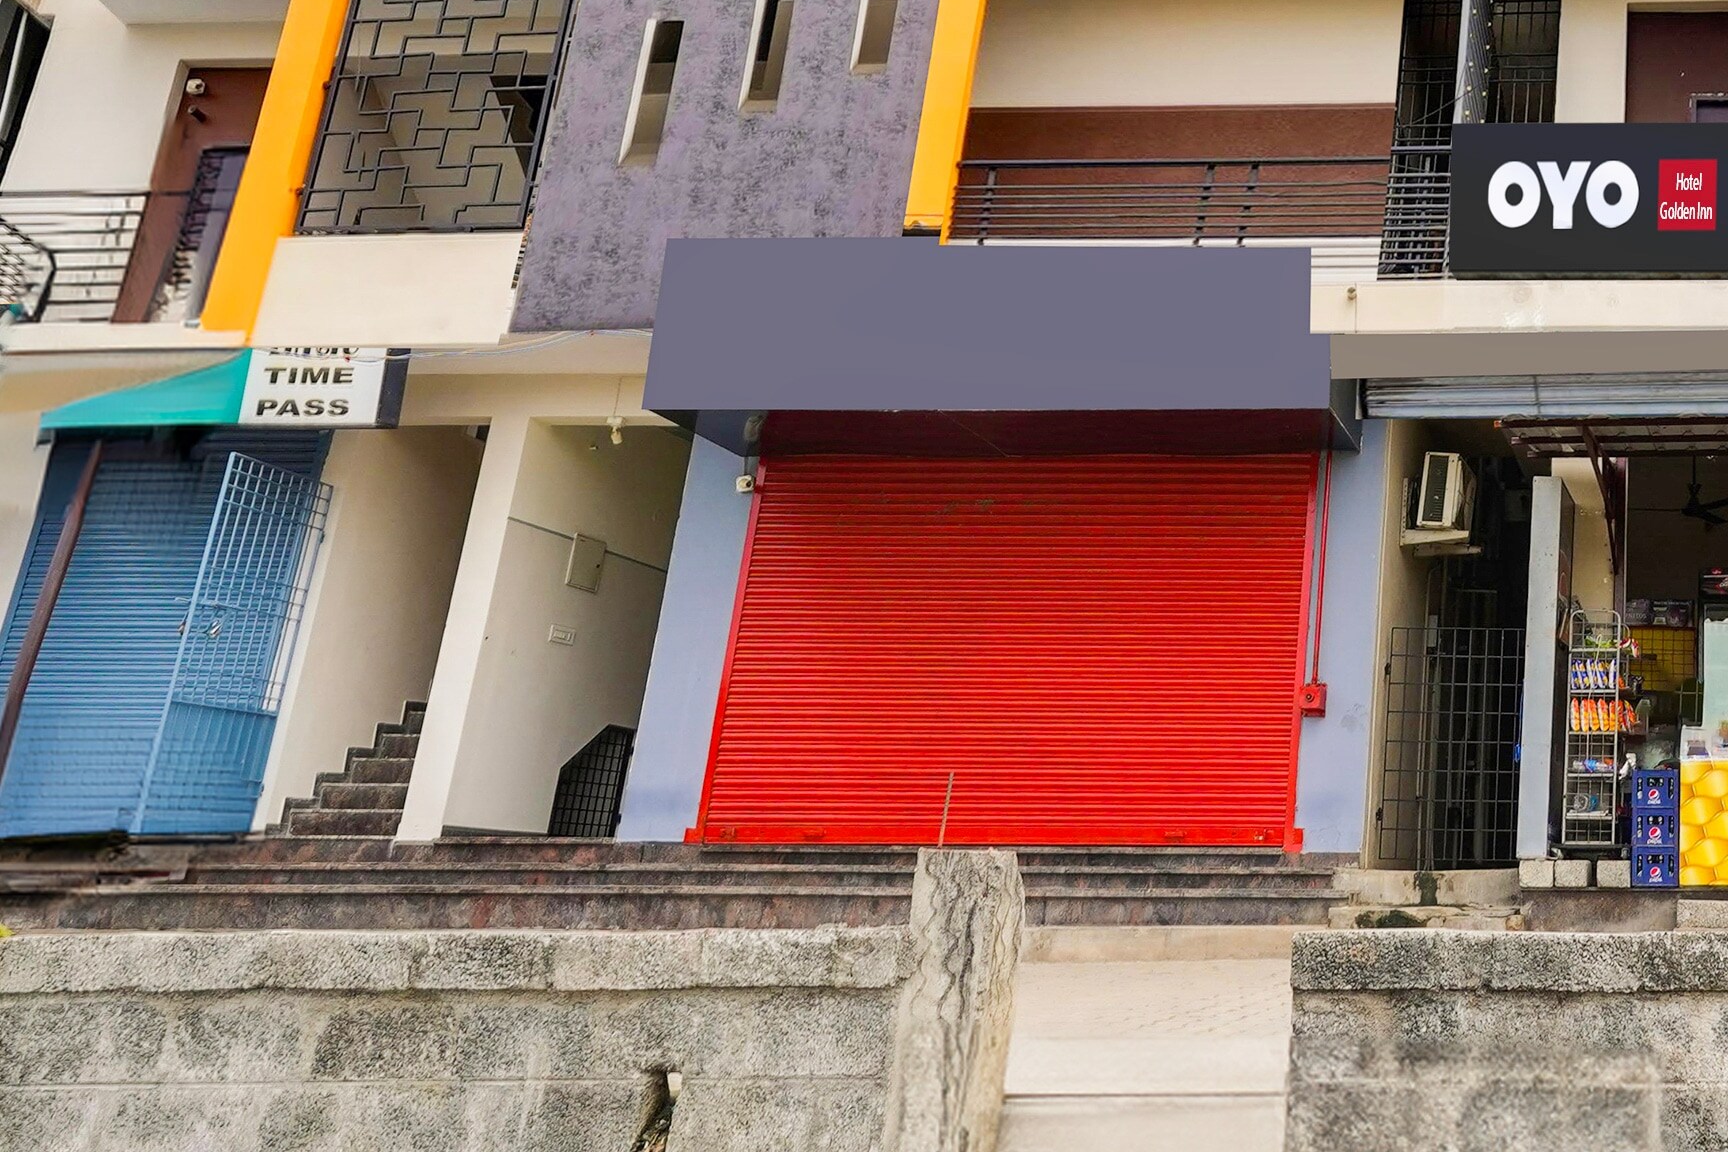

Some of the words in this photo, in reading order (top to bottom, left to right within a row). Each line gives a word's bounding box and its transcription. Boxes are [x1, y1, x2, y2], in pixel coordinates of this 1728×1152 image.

[1675, 172, 1703, 191] Hotel
[1487, 160, 1639, 230] OYO
[1659, 201, 1696, 220] Golden
[1697, 201, 1713, 220] Inn
[264, 367, 355, 385] TIME
[255, 399, 350, 417] PASS
